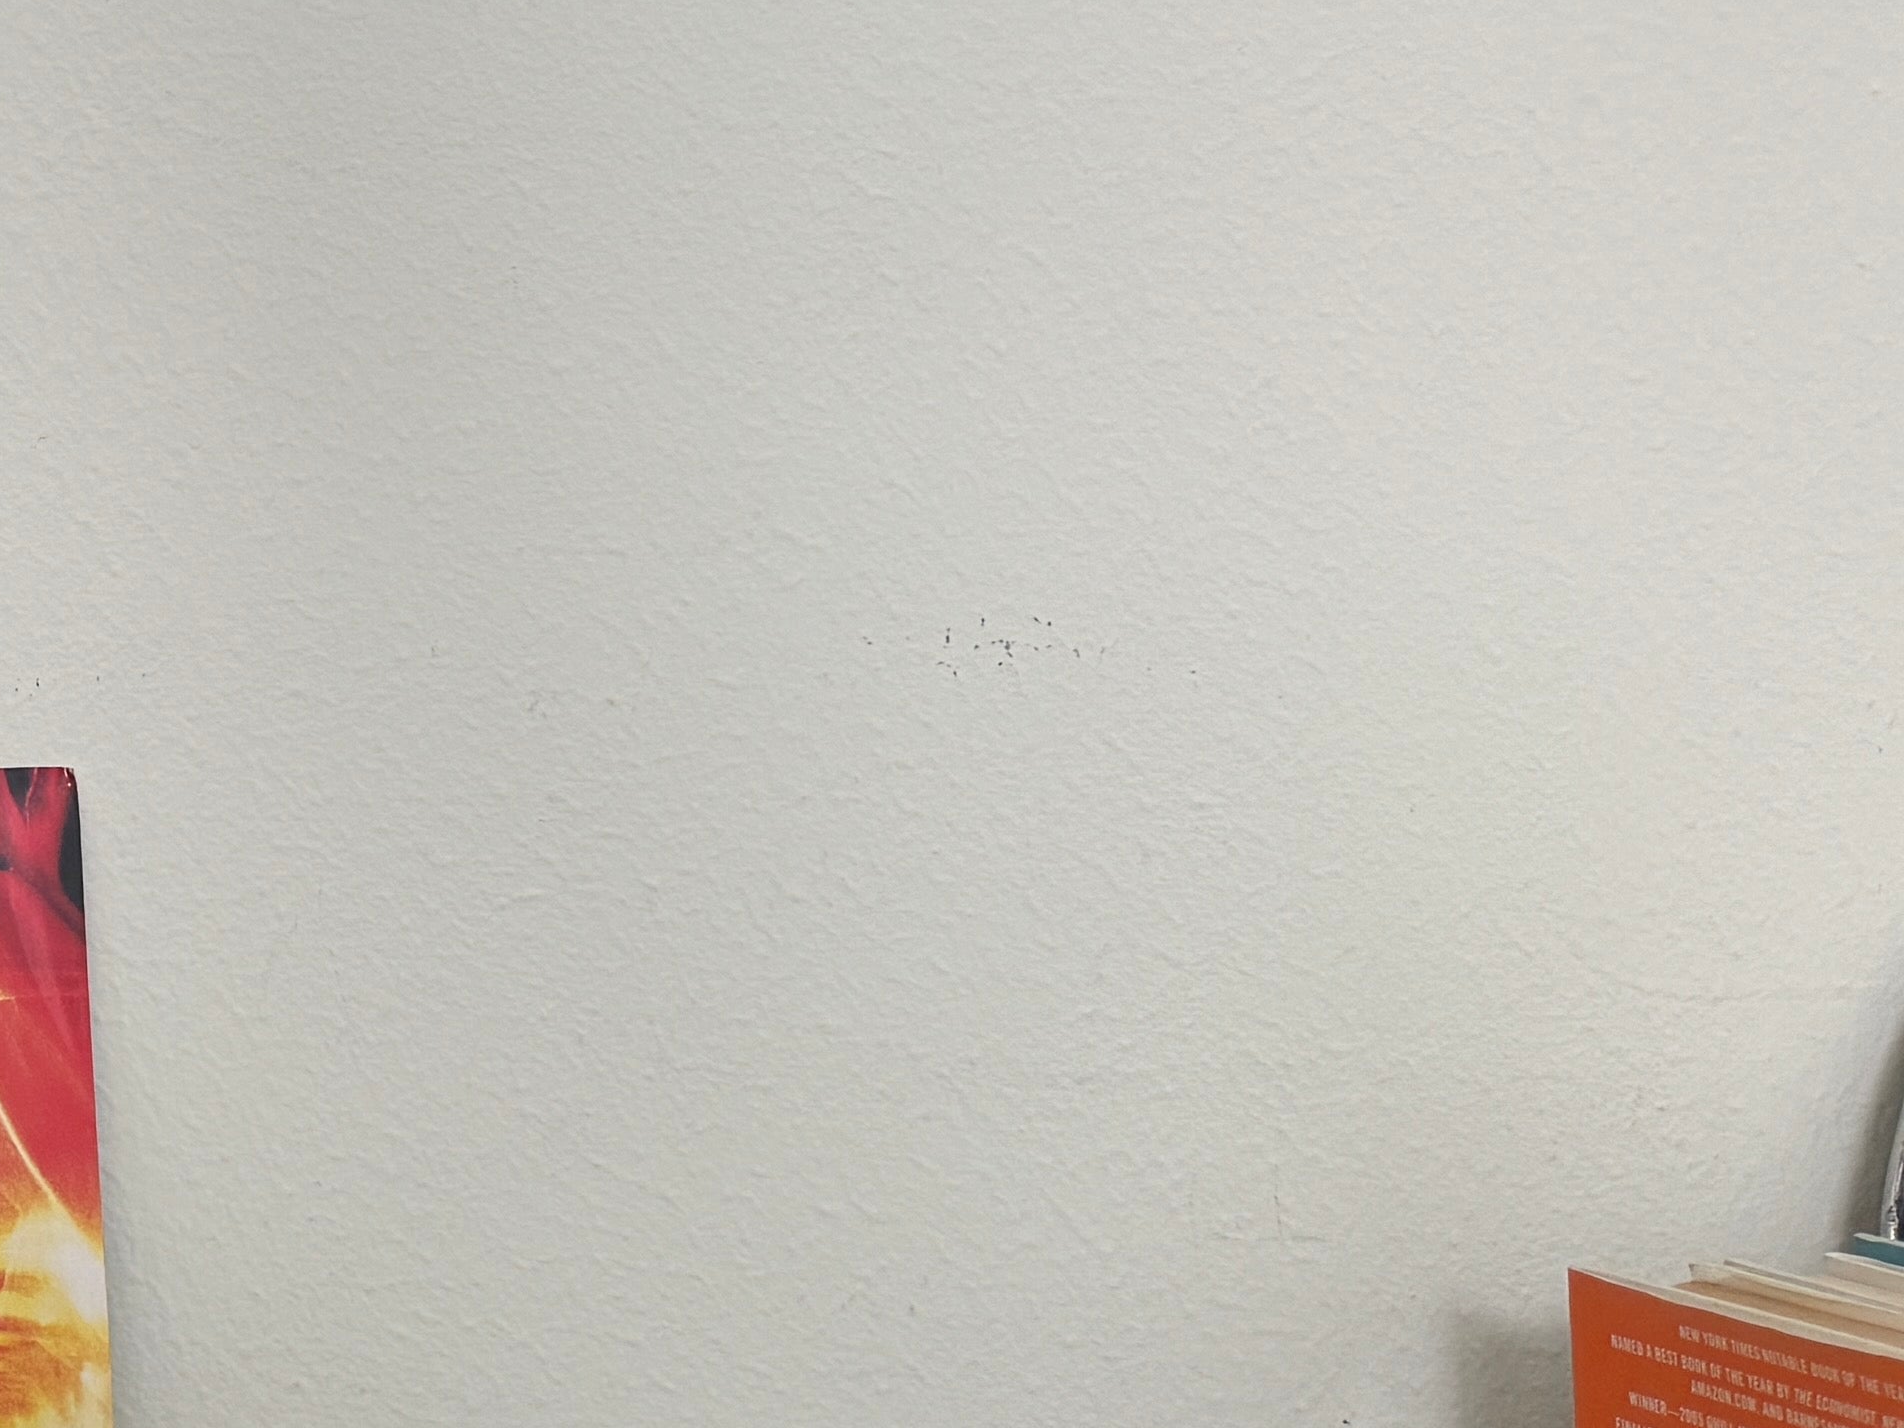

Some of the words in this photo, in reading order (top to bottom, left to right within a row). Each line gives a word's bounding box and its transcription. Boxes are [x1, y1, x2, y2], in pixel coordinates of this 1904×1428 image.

[1611, 1334, 1643, 1355] NAMED
[1654, 1346, 1677, 1365] BEST
[1725, 1367, 1743, 1386] THE
